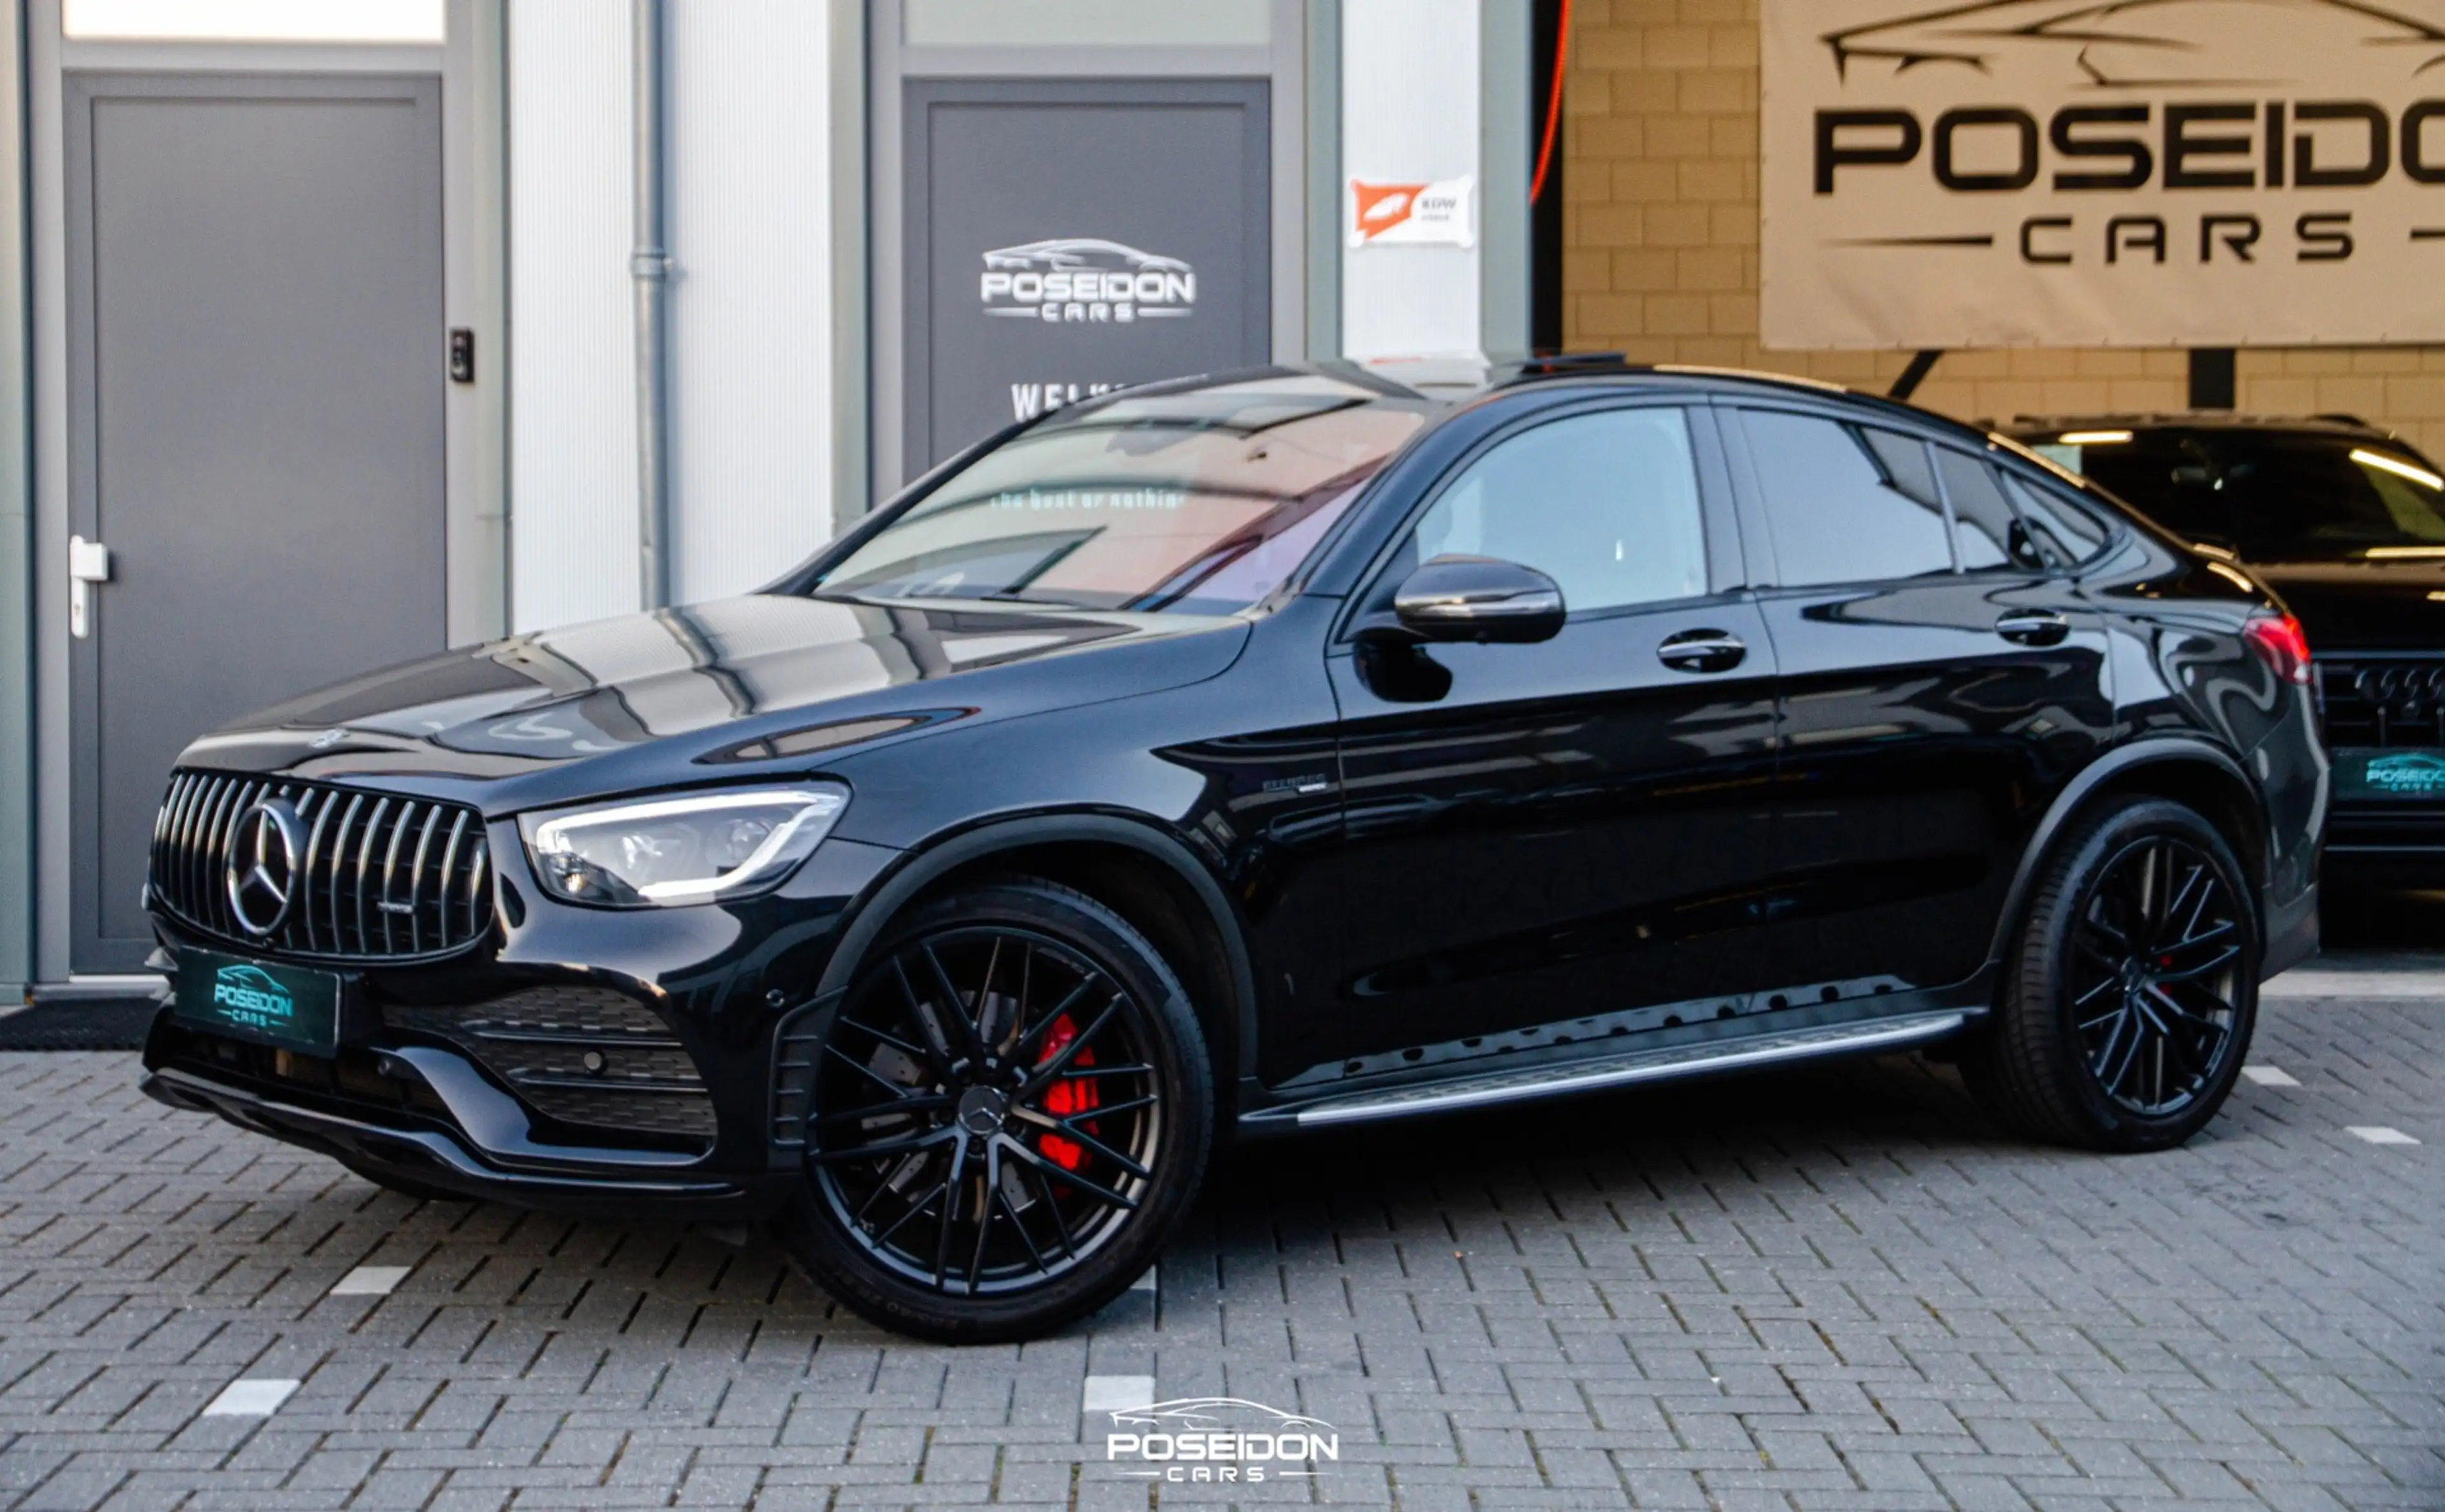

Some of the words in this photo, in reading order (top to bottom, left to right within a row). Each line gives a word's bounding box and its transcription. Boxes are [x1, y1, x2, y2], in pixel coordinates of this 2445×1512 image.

[2019, 211, 2354, 265] CARS
[981, 272, 1196, 303] POSEIDON
[1042, 303, 1135, 322] CARS
[214, 983, 293, 1017] POSEIDON
[232, 1009, 267, 1028] CARS
